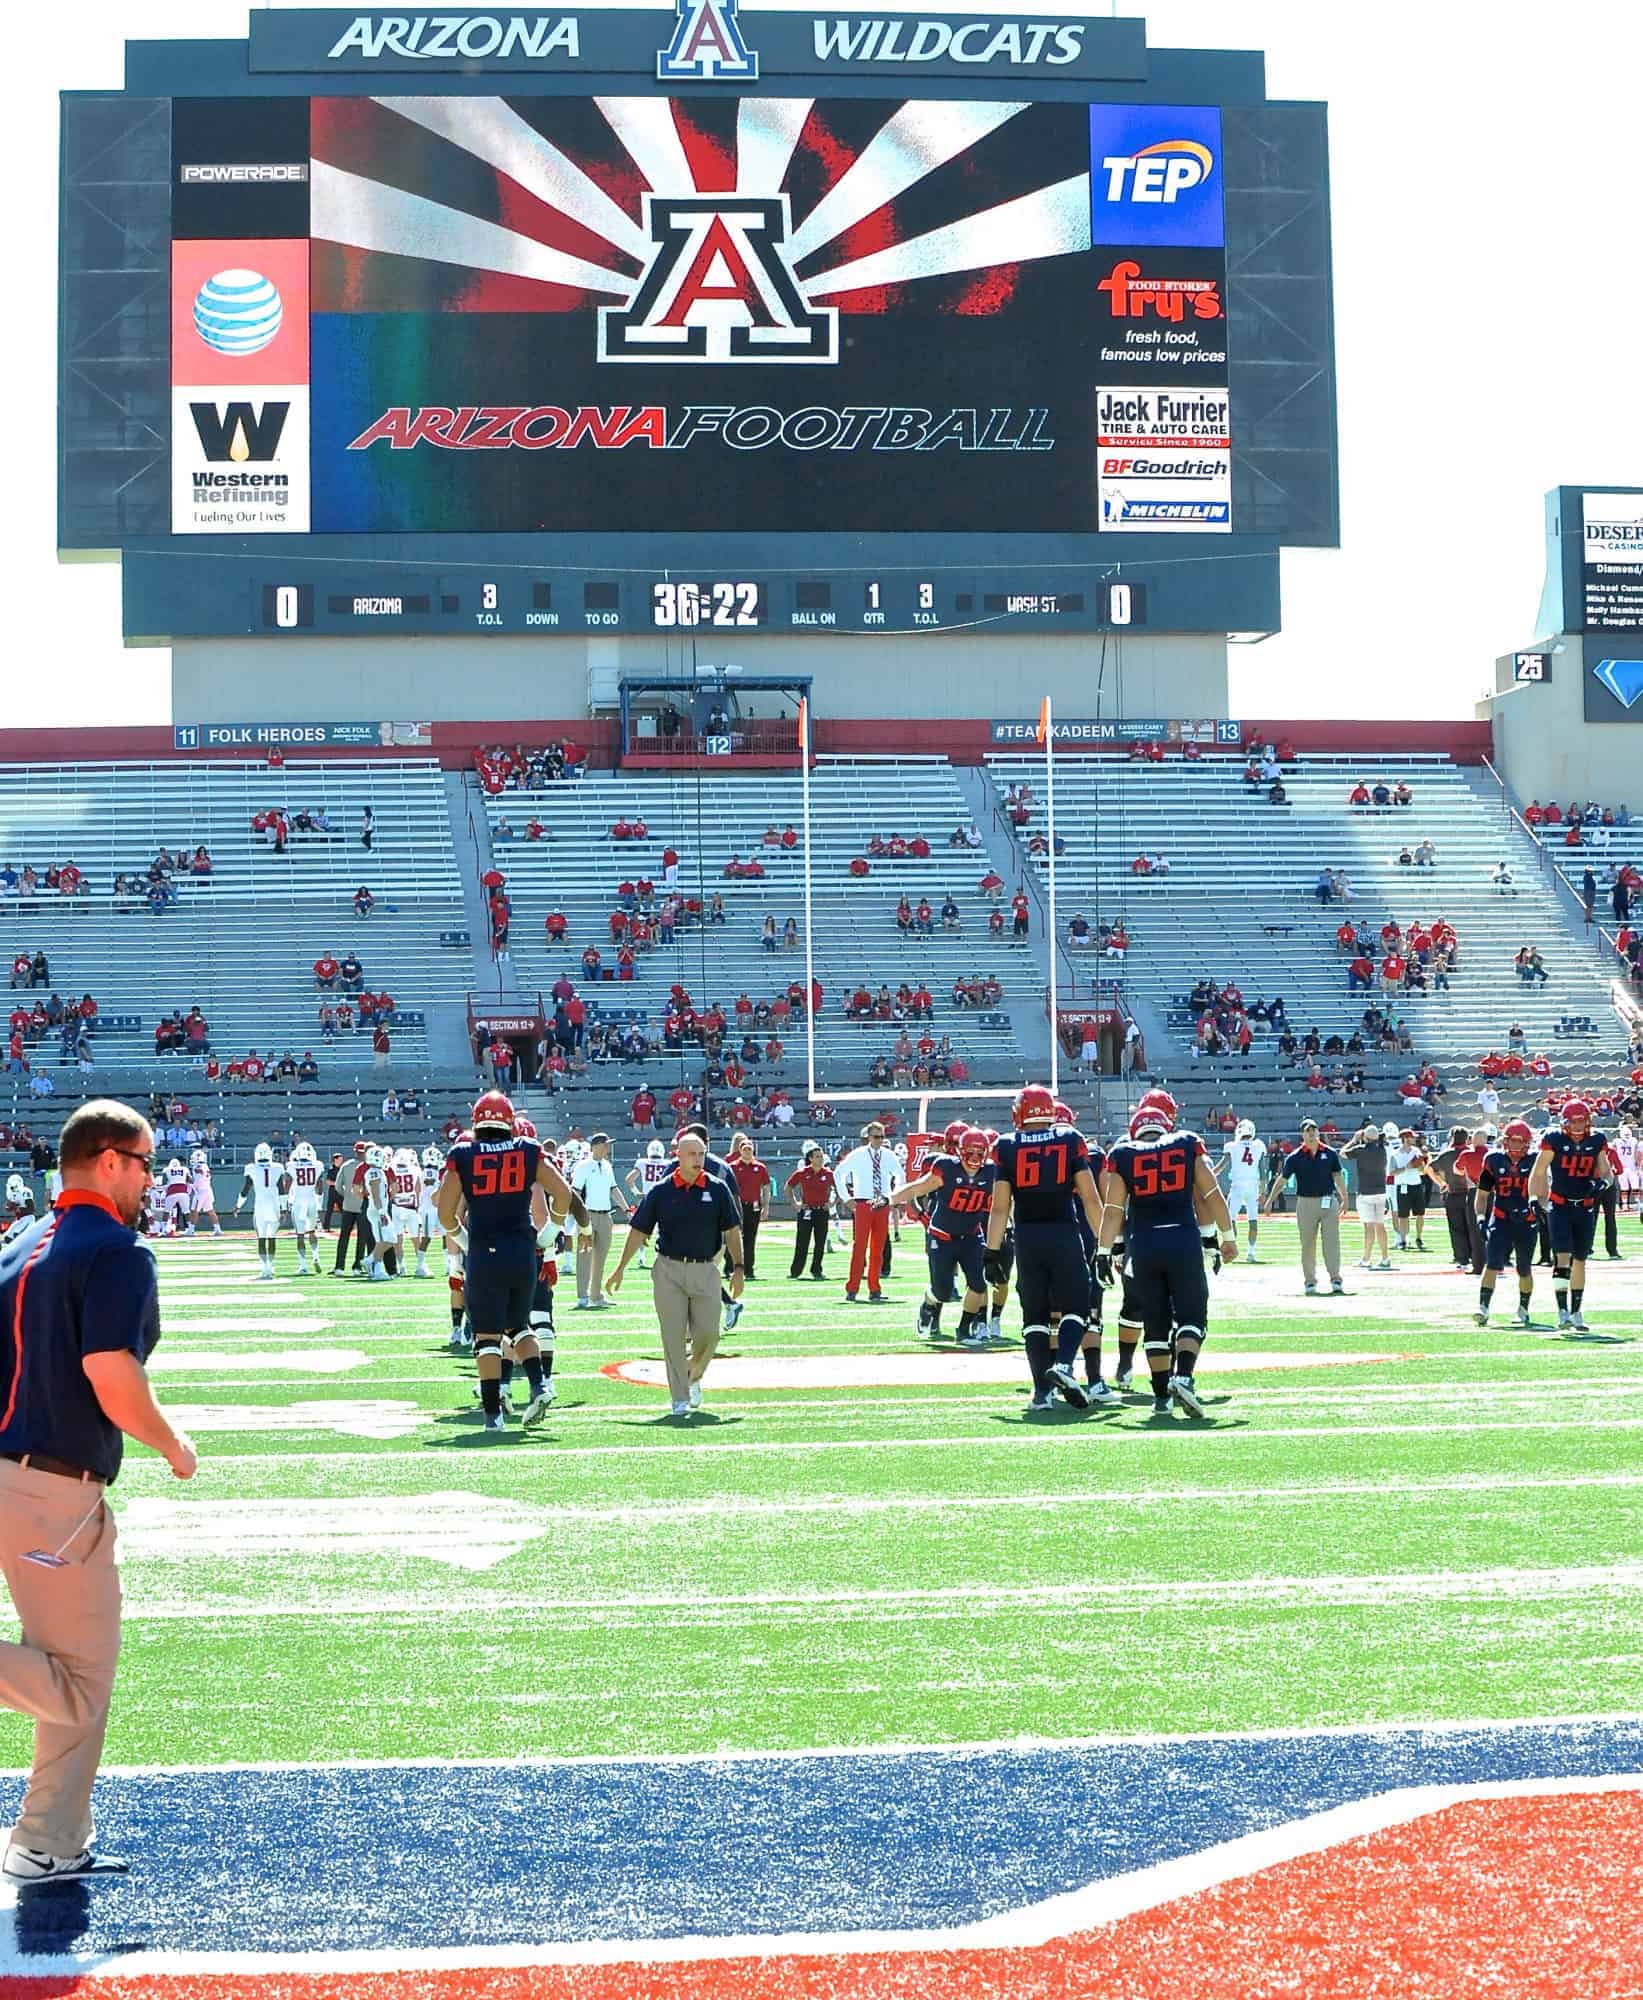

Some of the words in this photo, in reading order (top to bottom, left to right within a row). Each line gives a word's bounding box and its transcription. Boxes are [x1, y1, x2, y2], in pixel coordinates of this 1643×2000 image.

[328, 16, 581, 58] ARIZONA
[657, 0, 760, 79] A
[812, 20, 1085, 64] WILDCATS
[1102, 157, 1202, 203] TEP
[597, 192, 839, 363] A
[1125, 330, 1161, 343] fresh
[1165, 331, 1199, 346] food,
[1101, 348, 1152, 361] famous
[1156, 349, 1180, 362] low
[1182, 350, 1226, 365] prices
[1100, 394, 1150, 422] Jack
[1157, 395, 1227, 423] Furrier
[189, 401, 291, 462] W
[1103, 423, 1132, 434] TIRE
[1136, 424, 1146, 434] &
[1150, 424, 1187, 434] AUTO
[1191, 425, 1227, 435] CARE
[1156, 438, 1188, 446] Since
[1103, 459, 1227, 475] BFGoodrich
[192, 472, 289, 487] Western
[193, 488, 289, 505] Refining
[194, 511, 233, 524] Fueling
[236, 511, 256, 522] Our
[259, 511, 286, 522] Lives
[1129, 505, 1226, 518] MICHELIN
[483, 584, 497, 608] 3
[869, 583, 879, 608] 1
[919, 583, 933, 608] 3
[276, 586, 298, 627] 0
[353, 598, 402, 614] ARIZONA
[1110, 585, 1131, 625] 0
[526, 614, 558, 625] DOWN
[586, 614, 601, 625] TO
[602, 614, 618, 625] GO
[792, 613, 818, 624] BALL
[820, 613, 835, 624] ON
[864, 613, 884, 624] QTR
[1517, 655, 1543, 680] 25
[179, 730, 196, 744] 11
[209, 729, 251, 743] FOLK
[257, 728, 326, 742] HEROES
[1219, 724, 1239, 739] 13
[709, 738, 729, 753] 12
[1241, 1147, 1254, 1166] 4
[1560, 1155, 1594, 1176] 49
[472, 1151, 525, 1196] 58
[1017, 1144, 1067, 1188] 67
[1134, 1149, 1185, 1196] 55
[264, 1169, 269, 1187] 1
[296, 1168, 316, 1185] 80
[949, 1188, 985, 1212] 60
